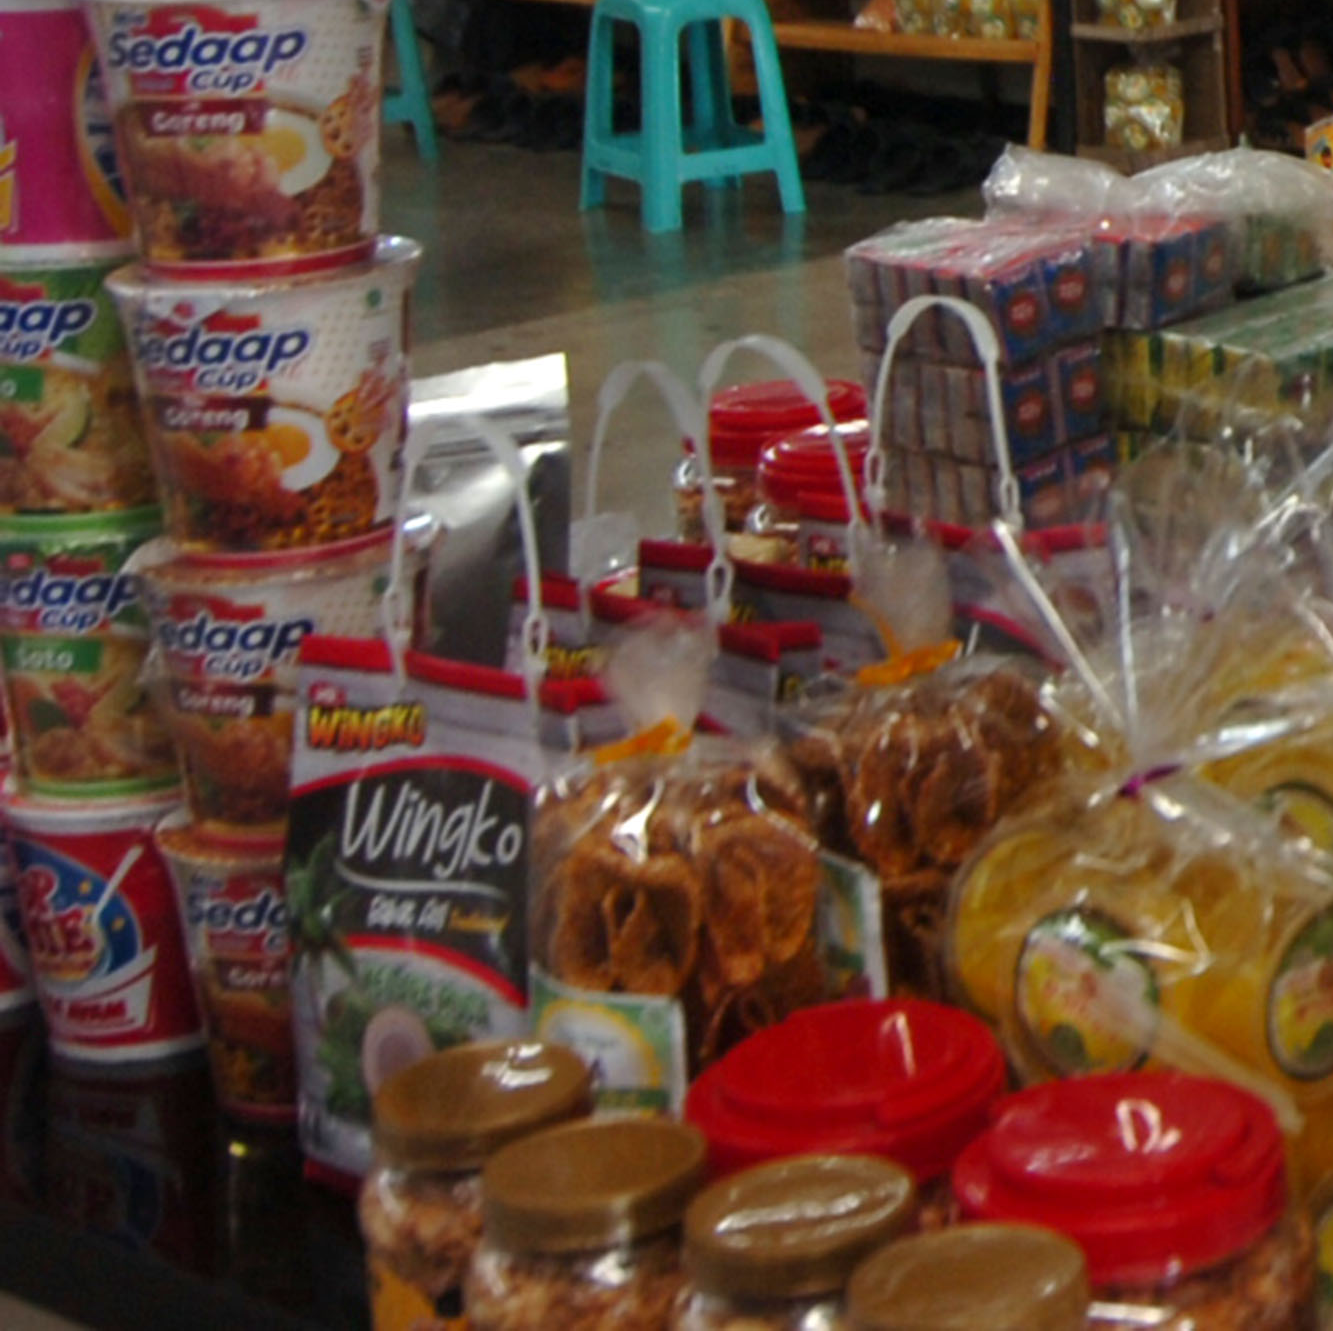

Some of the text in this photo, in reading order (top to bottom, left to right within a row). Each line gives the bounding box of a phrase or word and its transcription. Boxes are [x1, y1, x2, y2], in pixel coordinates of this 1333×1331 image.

[107, 26, 306, 72] Sedaap
[189, 69, 254, 94] Cup
[151, 111, 246, 133] Goreng
[197, 369, 259, 391] Cup
[41, 608, 99, 632] Cup
[205, 657, 262, 677] Cup
[308, 703, 426, 751] WINGKO
[341, 778, 524, 879] Wingko
